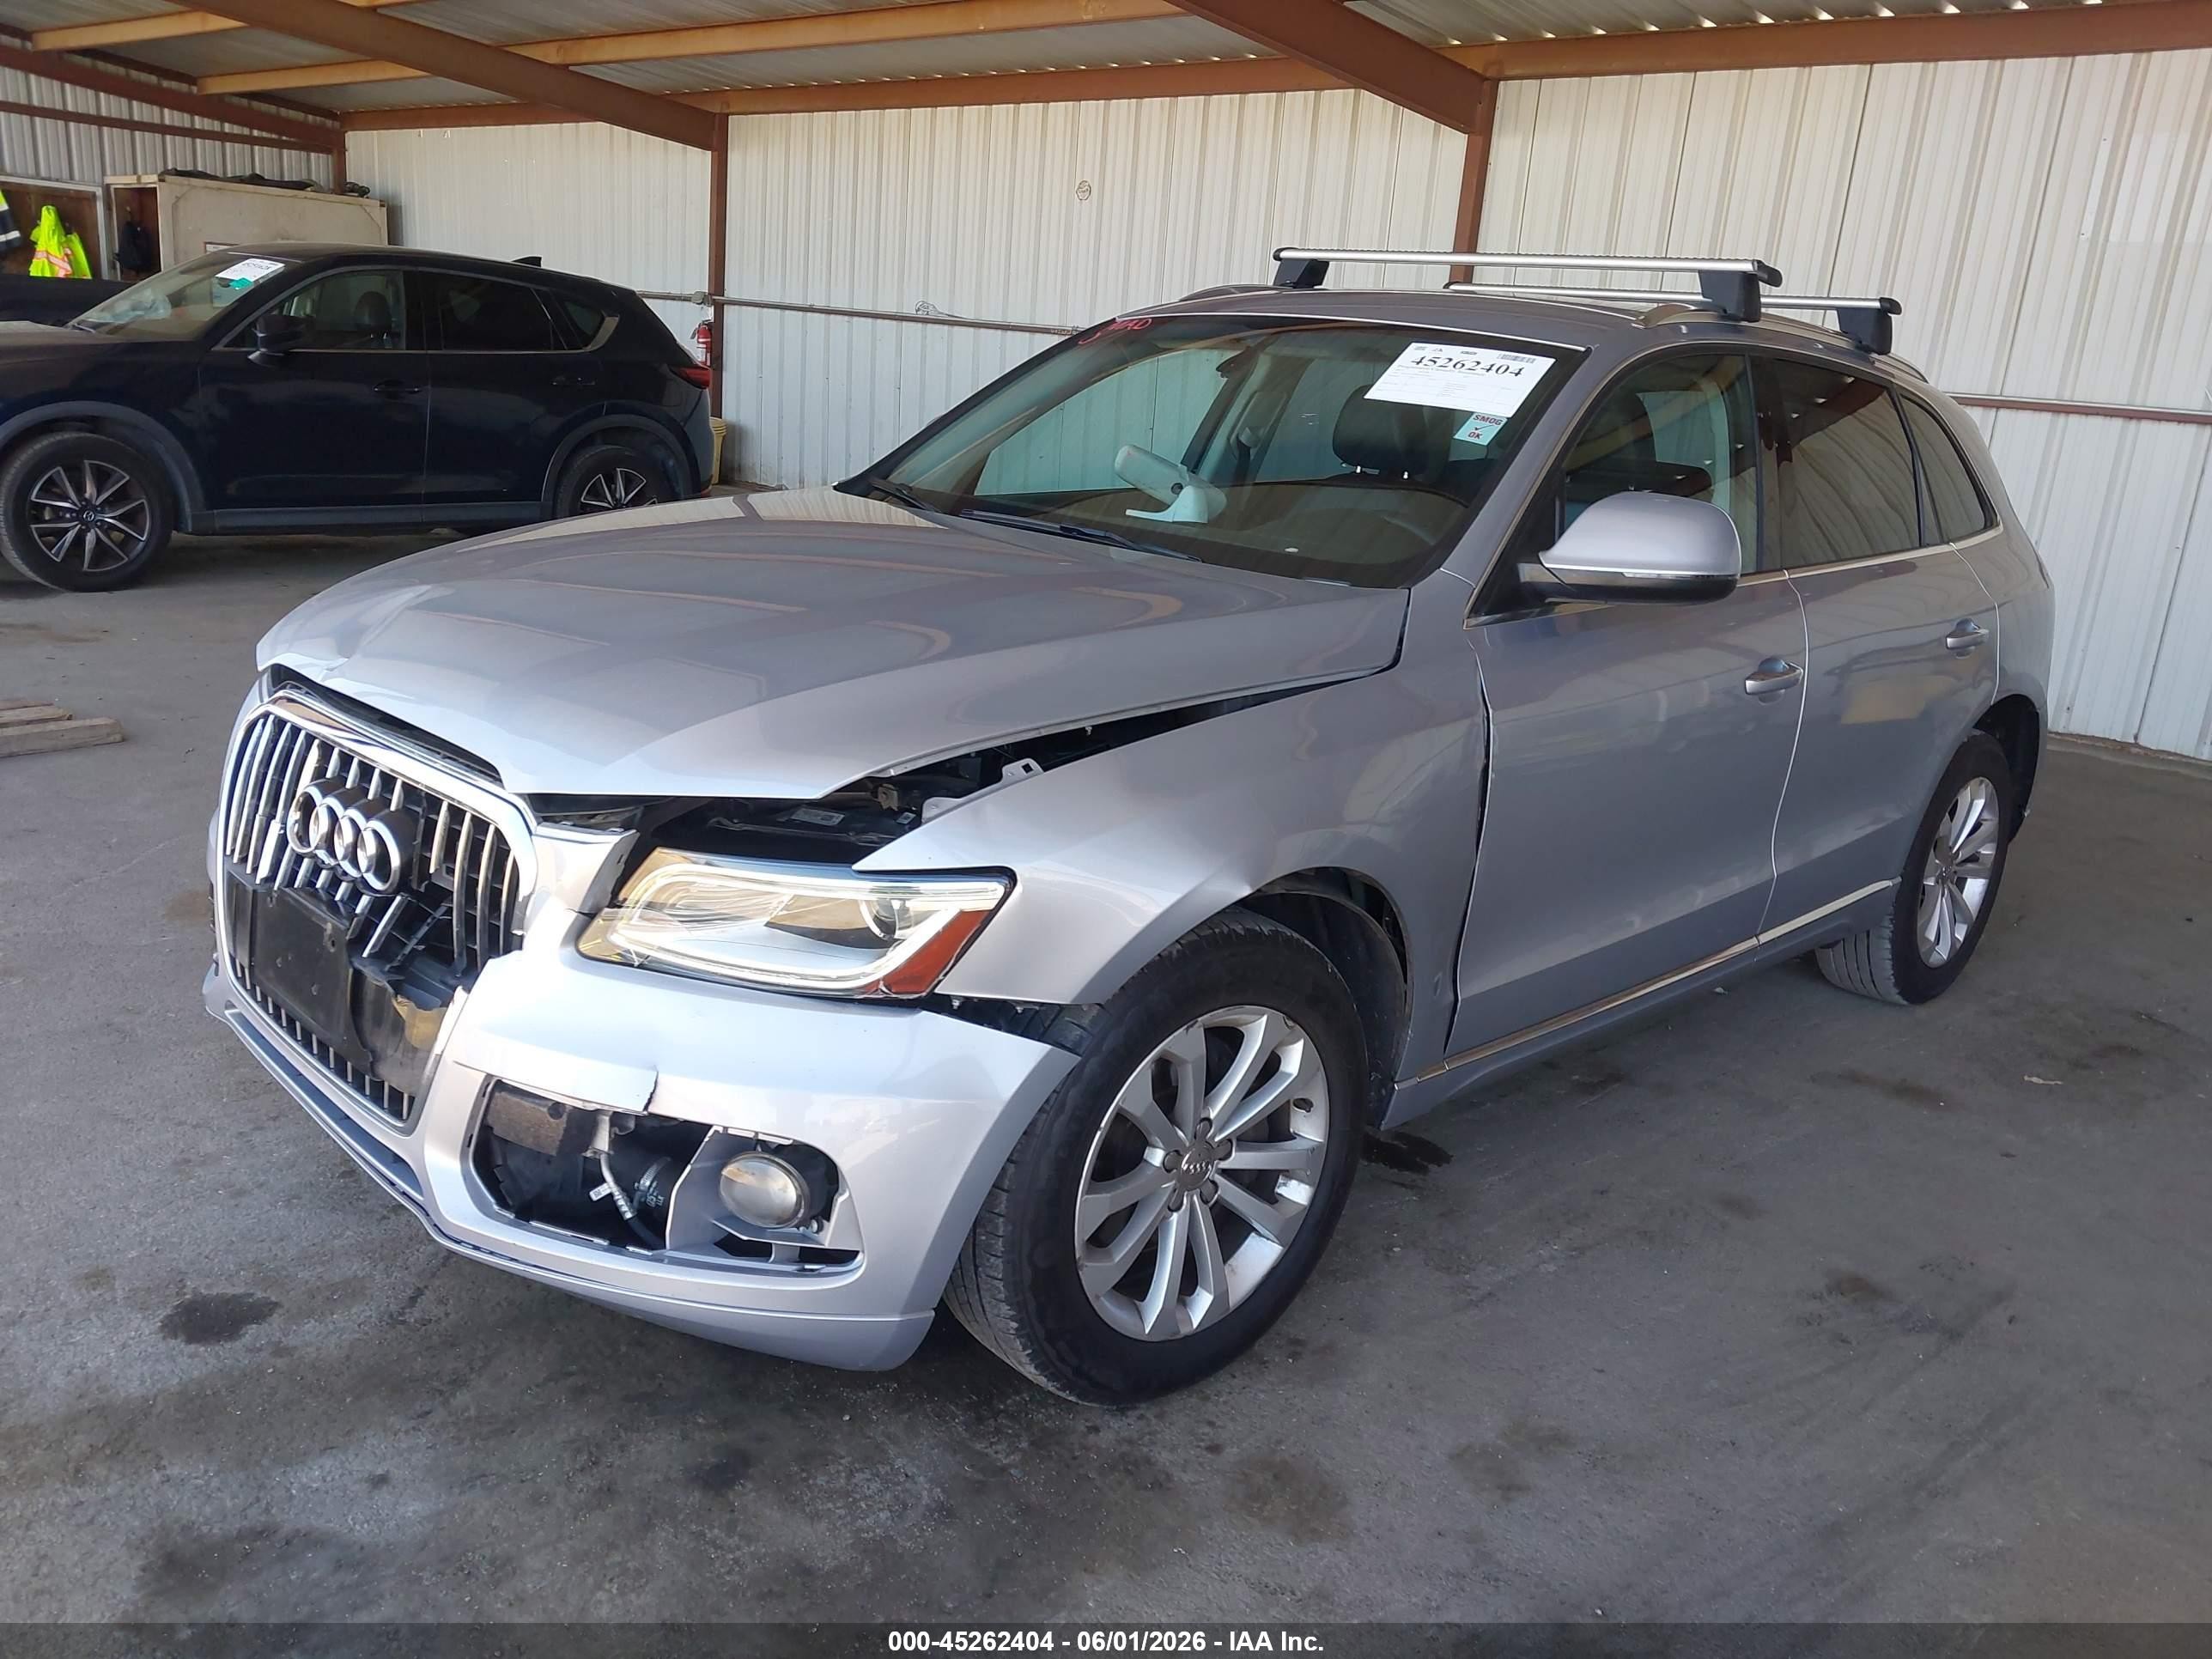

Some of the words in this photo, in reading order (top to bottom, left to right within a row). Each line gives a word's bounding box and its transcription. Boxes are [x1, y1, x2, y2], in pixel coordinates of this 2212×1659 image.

[1411, 356, 1525, 378] 45262404
[1473, 414, 1503, 427] SMOG
[1468, 430, 1483, 441] OK
